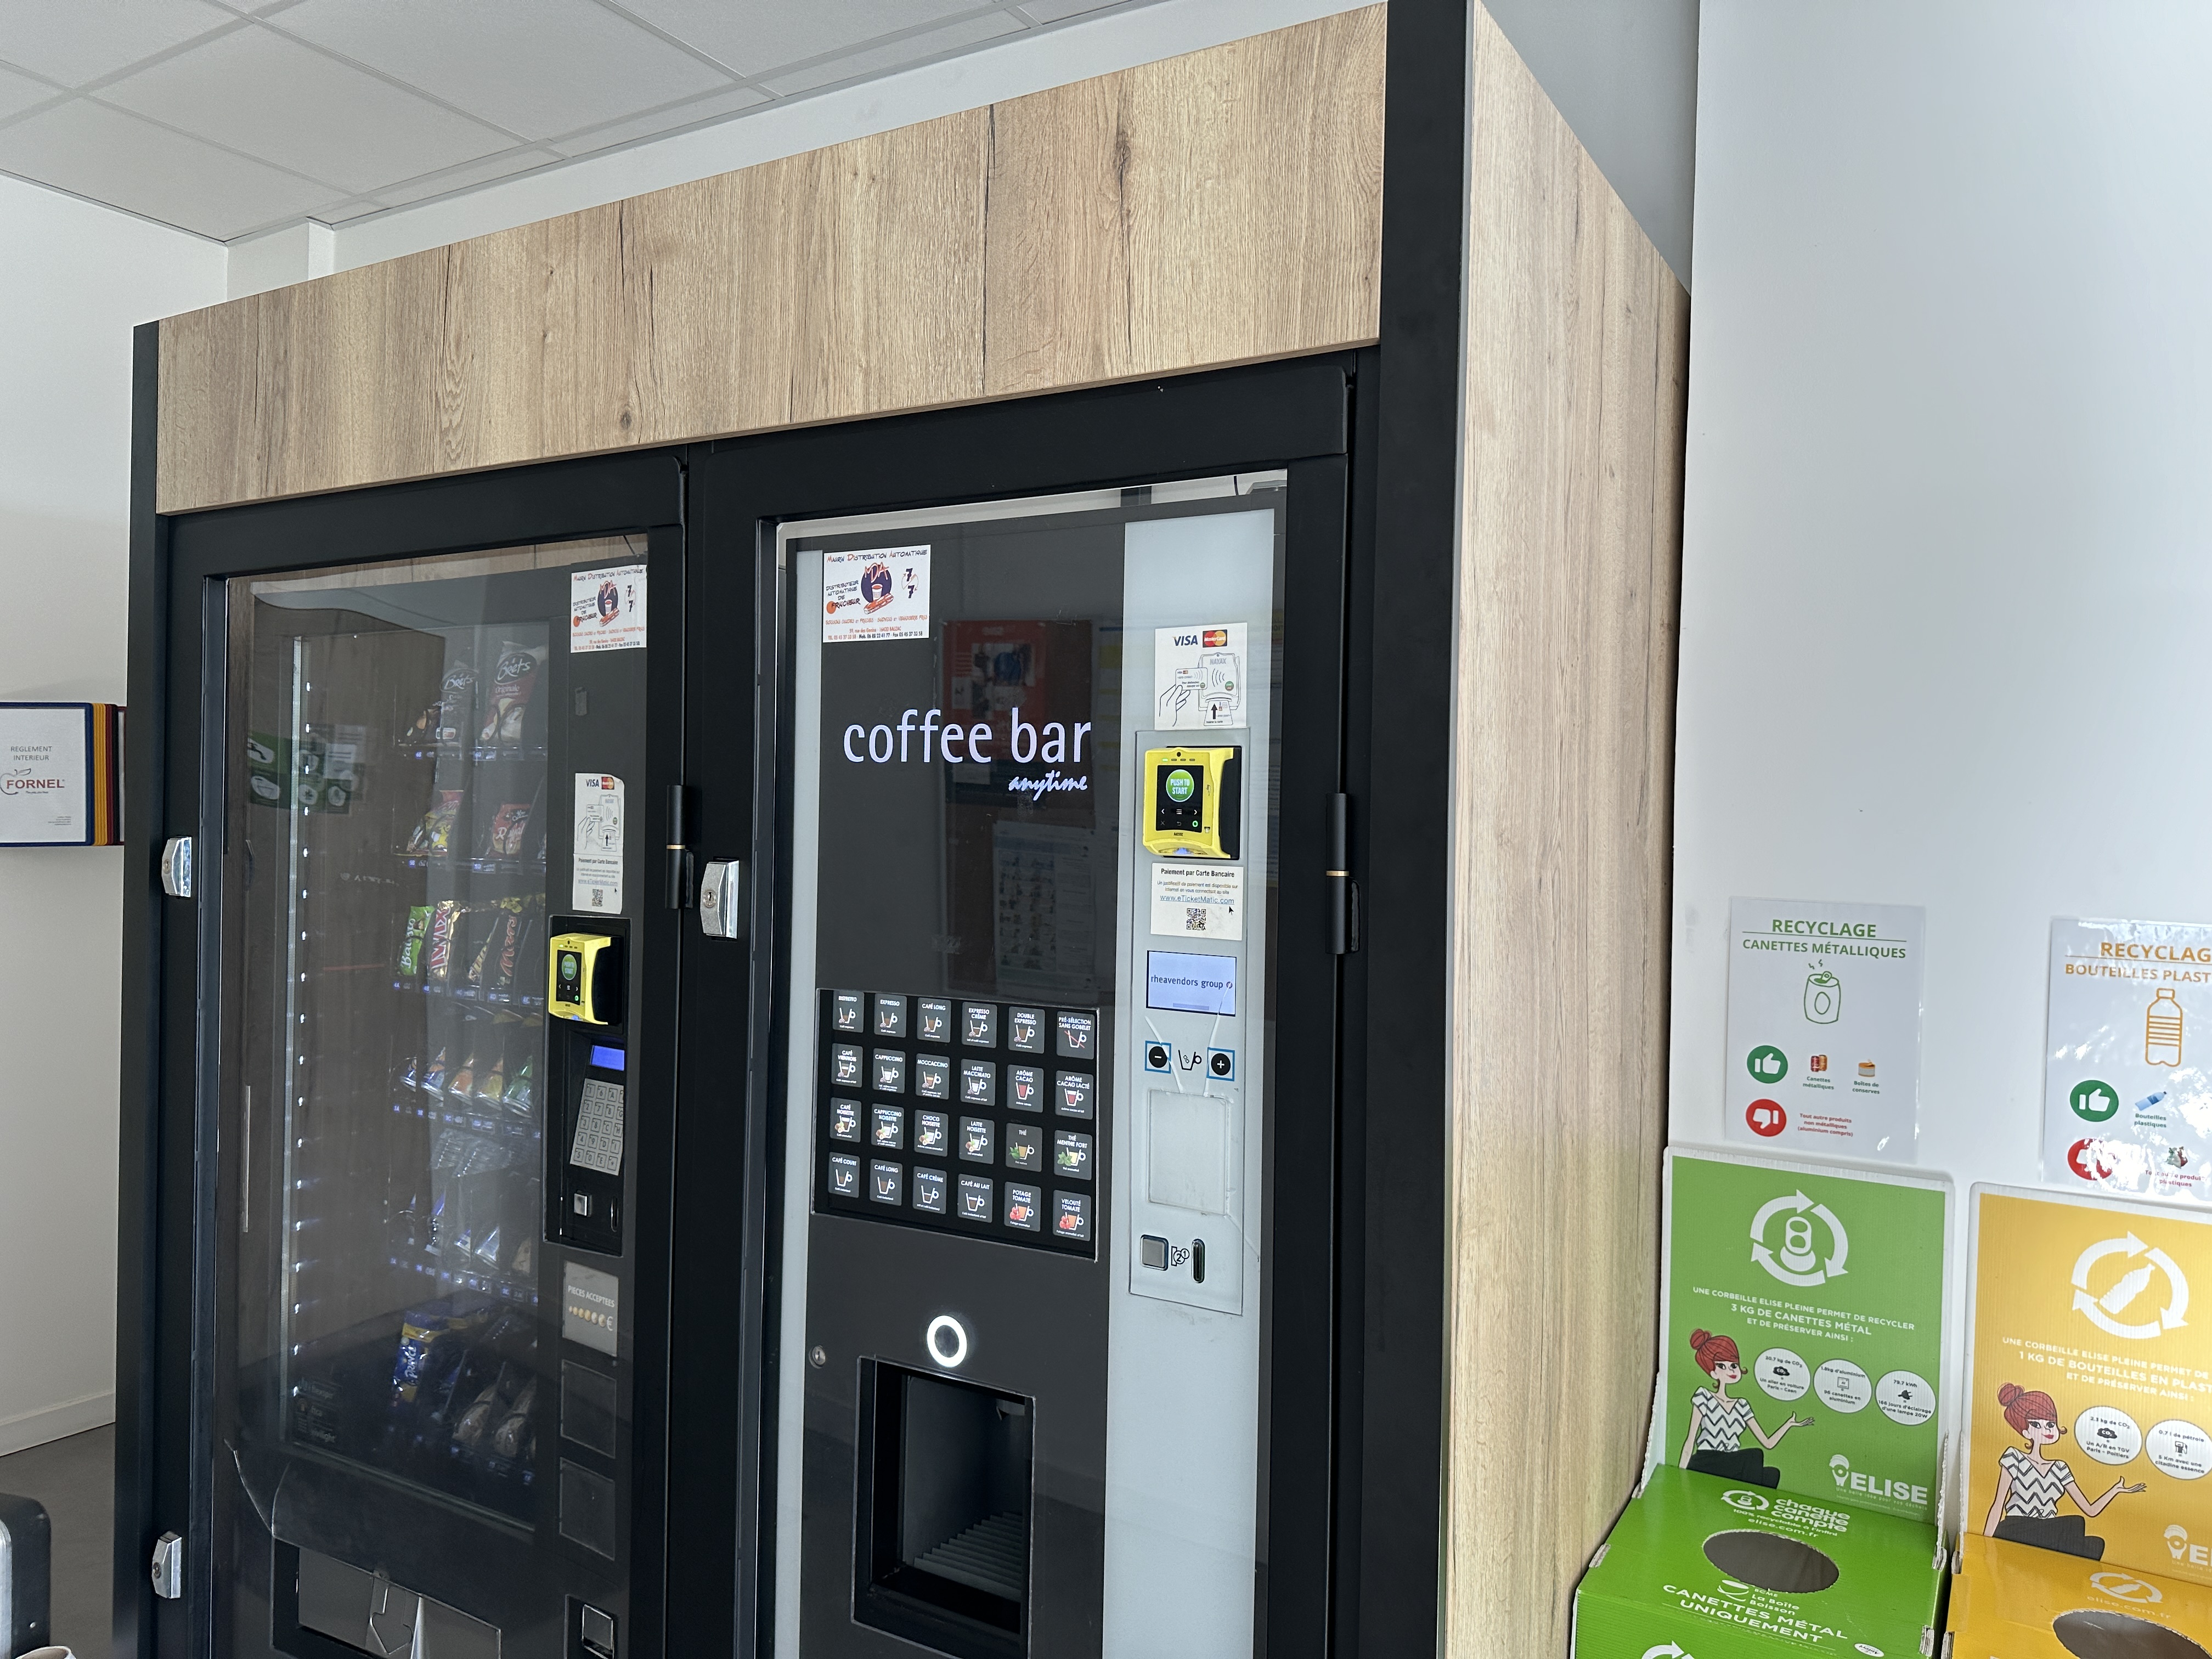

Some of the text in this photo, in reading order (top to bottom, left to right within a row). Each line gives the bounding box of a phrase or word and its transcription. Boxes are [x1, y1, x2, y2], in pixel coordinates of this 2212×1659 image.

[847, 553, 887, 561] DISTRIBUTION
[889, 550, 927, 558] AUTOMATIQUE
[906, 568, 913, 582] 7
[908, 585, 915, 599] 7
[1172, 635, 1198, 646] VISA
[844, 707, 1091, 763] coffee bar
[7, 779, 64, 789] FORNEL
[586, 778, 599, 787] VISA
[1008, 770, 1088, 800] anytime
[1160, 895, 1234, 905] www.eTicketMatic.com
[1772, 919, 1876, 938] RECYCLAGE
[1742, 939, 1906, 959] CANETTES MÉTALLIQUES
[2101, 942, 2212, 962] RECYCLAG
[2066, 963, 2212, 983] BOUTEILLES PLAST
[1151, 975, 1223, 990] rheavendors group
[1058, 1016, 1091, 1025] PRÉ-SÉLECTION
[963, 1070, 991, 1079] MACCHIATO
[874, 1109, 902, 1117] CAPPUCCINO
[1815, 1121, 1847, 1130] métalliques
[1830, 1130, 1853, 1138] compris)
[1012, 1195, 1031, 1203] TOMATE
[1062, 1198, 1081, 1206] VELOUTÉ
[1062, 1204, 1080, 1212] TOMATE
[568, 1285, 615, 1307] PIECES ACCEPTEES
[1693, 1286, 1915, 1330] UNE CORBEILLE ELISE PLEINE PERMET DE RECYCLER
[1731, 1304, 1871, 1335] 3 KG DE CANETTES MÉTAL
[1759, 1319, 1771, 1328] DE
[1773, 1321, 1822, 1338] PRÉSERVER
[1825, 1331, 1848, 1341] AINSI
[2002, 1336, 2209, 1380] UNE CORBEILLE ELISE PLEINE PERMET DE
[2019, 1351, 2212, 1394] 1 KG DE BOUTEILLES EN PLAST
[2067, 1372, 2188, 1401] ET DE PRÉSERVER AINSI
[2182, 1434, 2204, 1443] pétrole
[2107, 1450, 2129, 1459] Poitiers
[2155, 1460, 2205, 1474] citadine essence
[1850, 1471, 1927, 1505] ELISE
[1774, 1504, 1848, 1526] canette
[1776, 1499, 1850, 1520] chaque
[1748, 1517, 1819, 1537] elise.com.fr
[1771, 1510, 1847, 1532] compte
[1663, 1584, 1770, 1620] CANETTES
[1777, 1614, 1848, 1639] MÉTAL
[1750, 1599, 1796, 1616] Boisson
[1680, 1599, 1822, 1643] UNIQUEMENT
